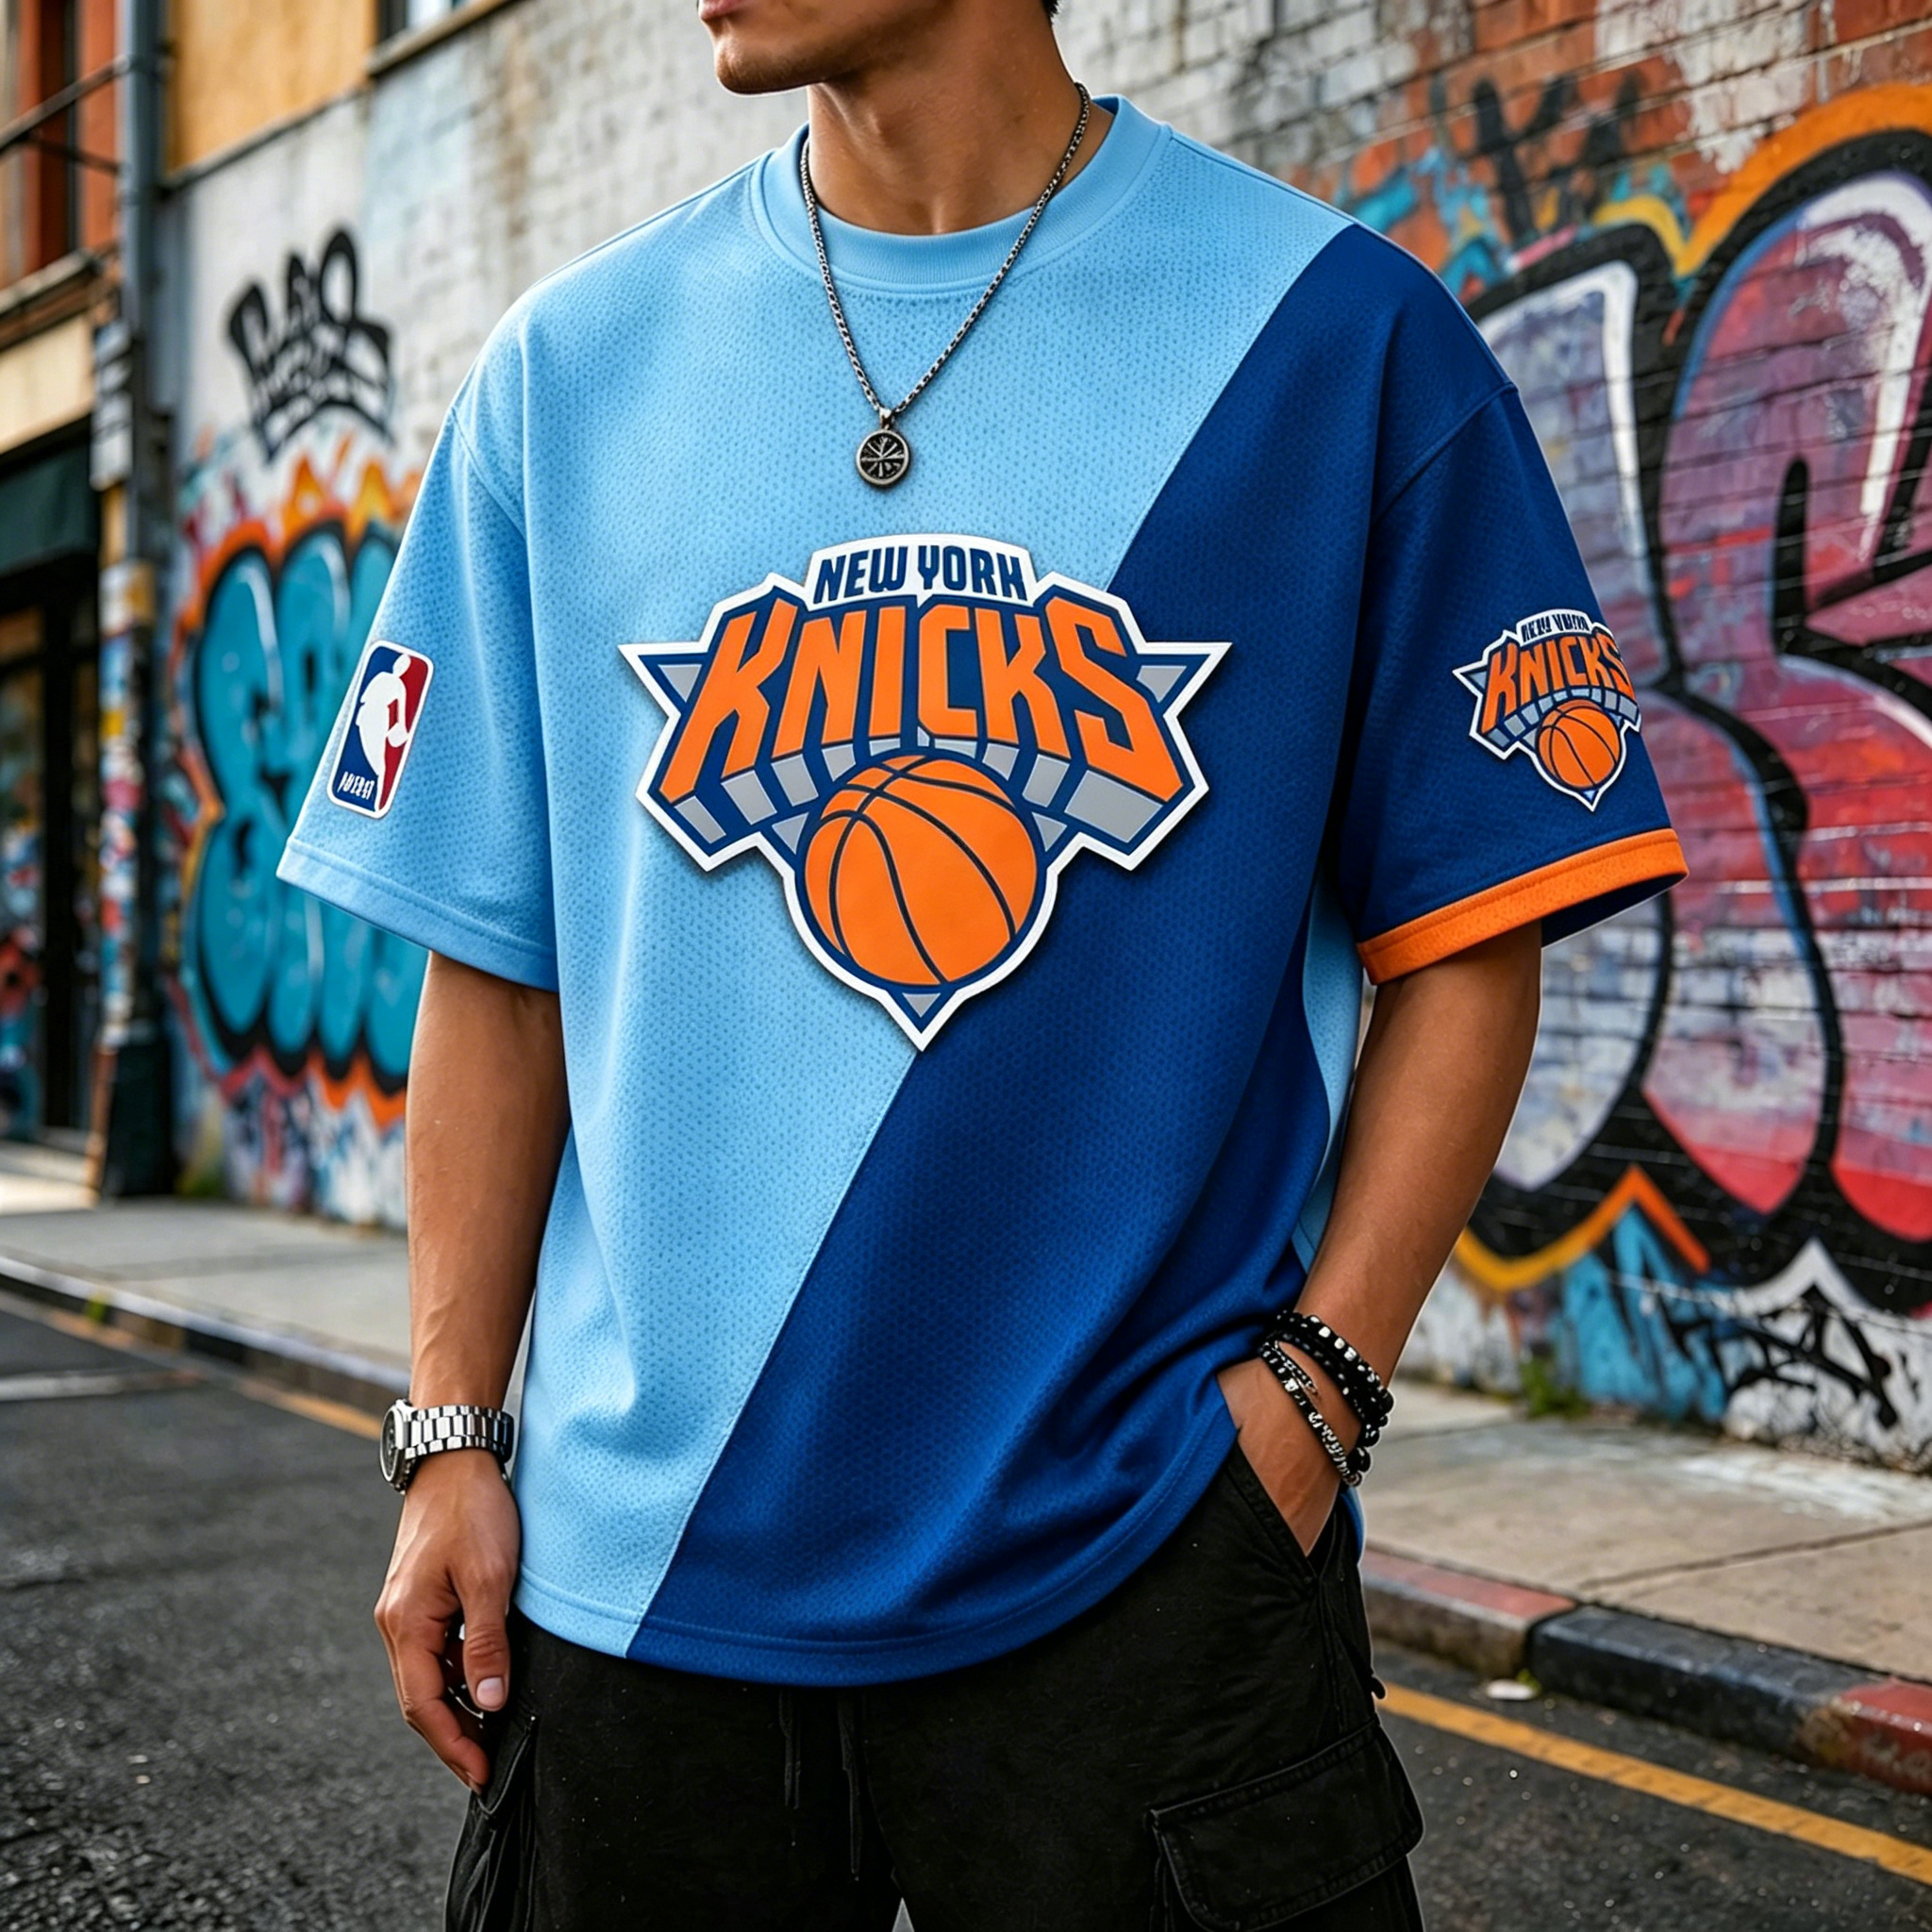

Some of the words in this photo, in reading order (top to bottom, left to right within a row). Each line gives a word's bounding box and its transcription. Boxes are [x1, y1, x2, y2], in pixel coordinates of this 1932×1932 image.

[812, 545, 909, 605] NEW
[917, 544, 1028, 602] YORK
[658, 595, 1185, 804] KNICKS
[1481, 632, 1636, 734] KNICKS
